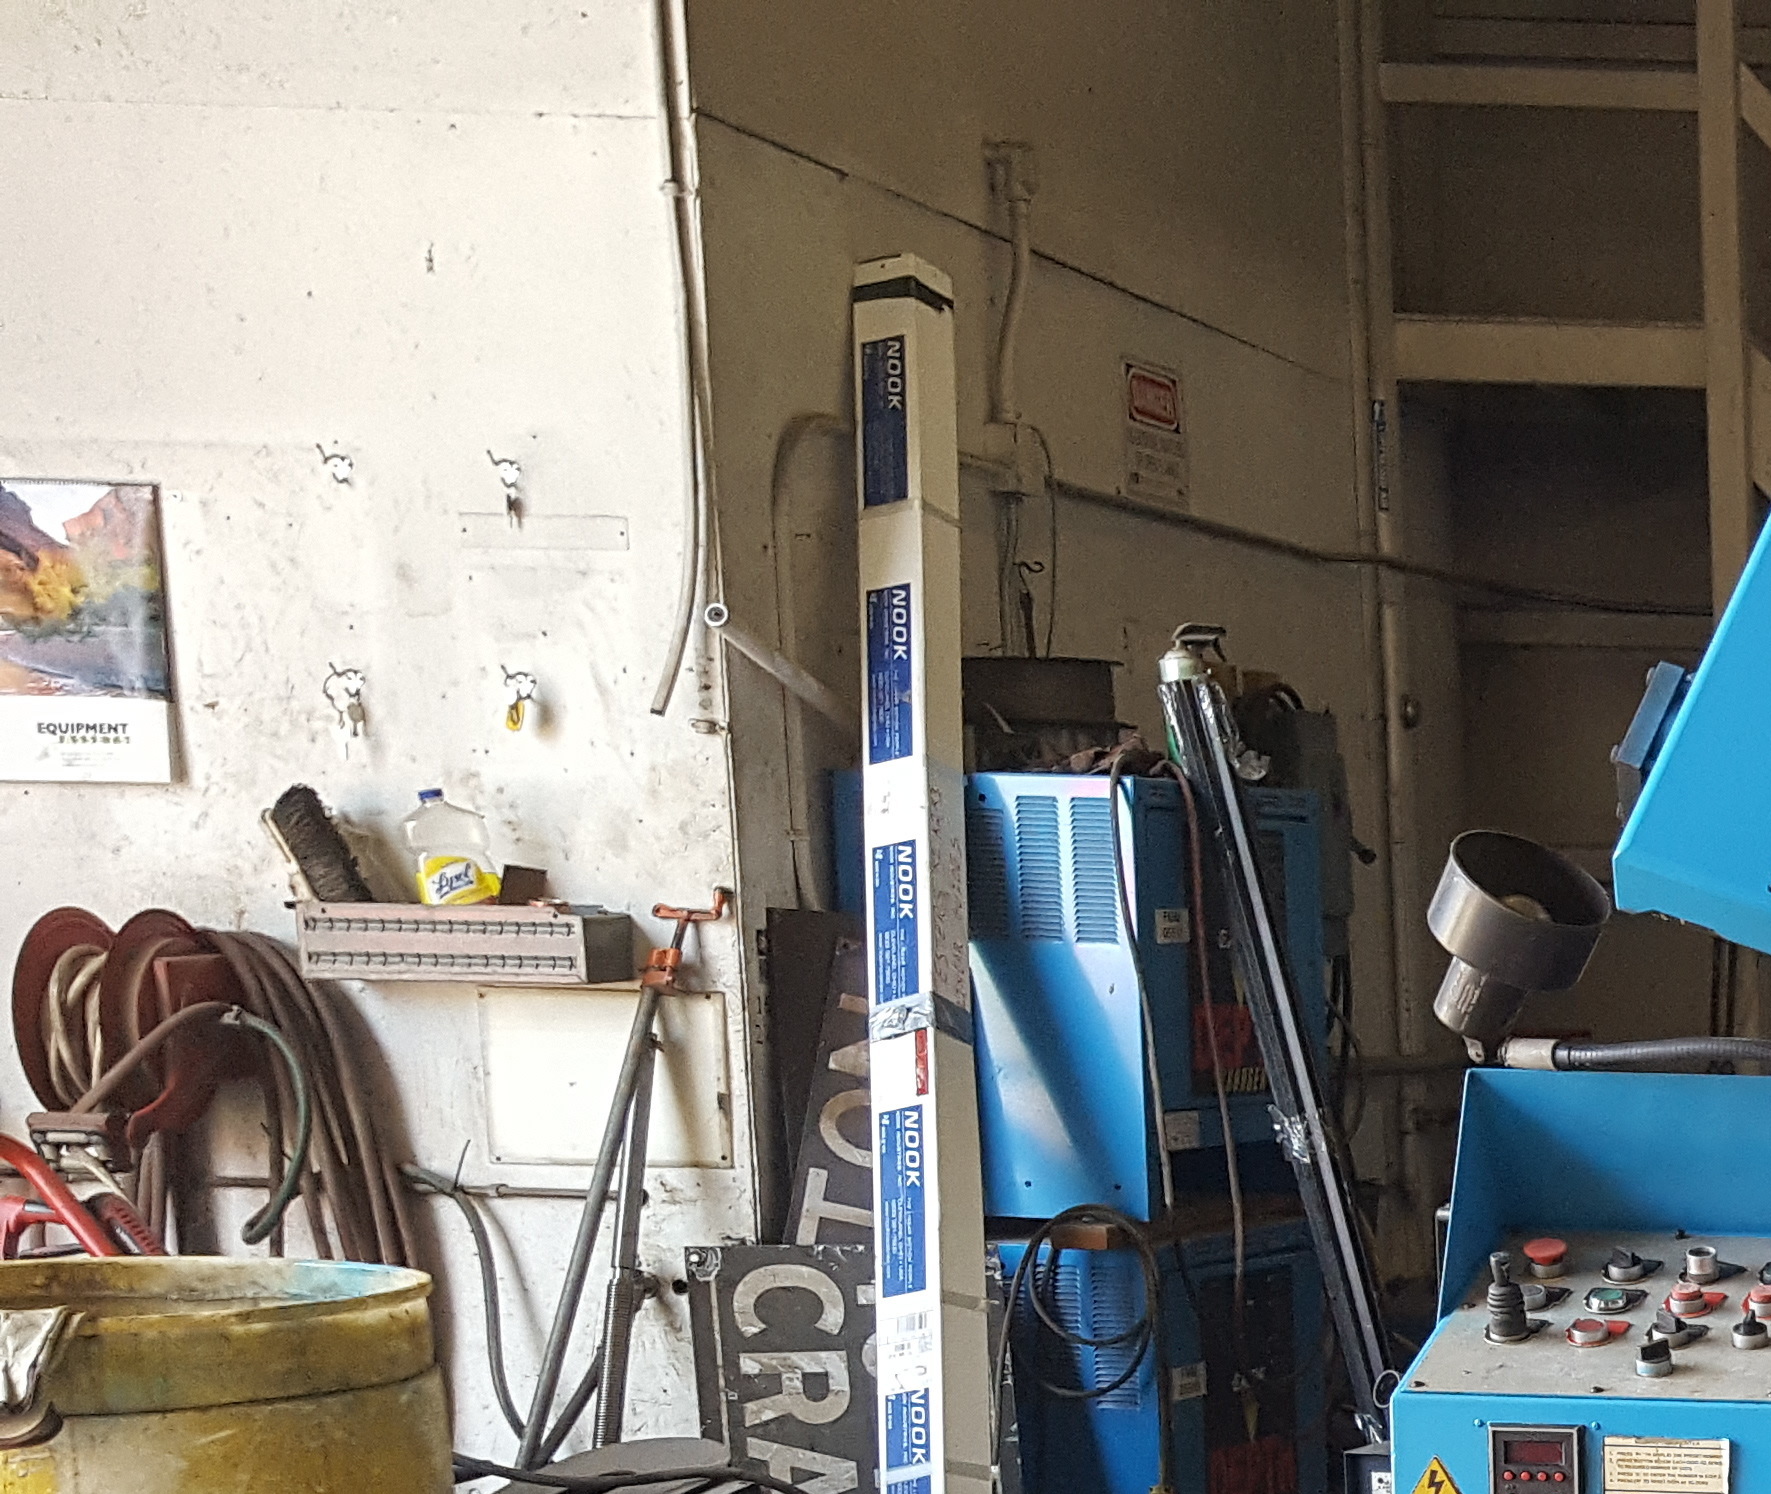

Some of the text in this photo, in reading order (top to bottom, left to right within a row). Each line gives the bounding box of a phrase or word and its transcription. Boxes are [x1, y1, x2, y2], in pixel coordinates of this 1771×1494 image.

[887, 340, 902, 409] NOOK
[892, 589, 908, 660] NOOK
[37, 722, 128, 736] EQUIPMENT
[432, 862, 474, 899] Lysol
[898, 845, 914, 919] NOOK
[905, 1110, 921, 1187] NOOK
[911, 1388, 926, 1464] NOOK
